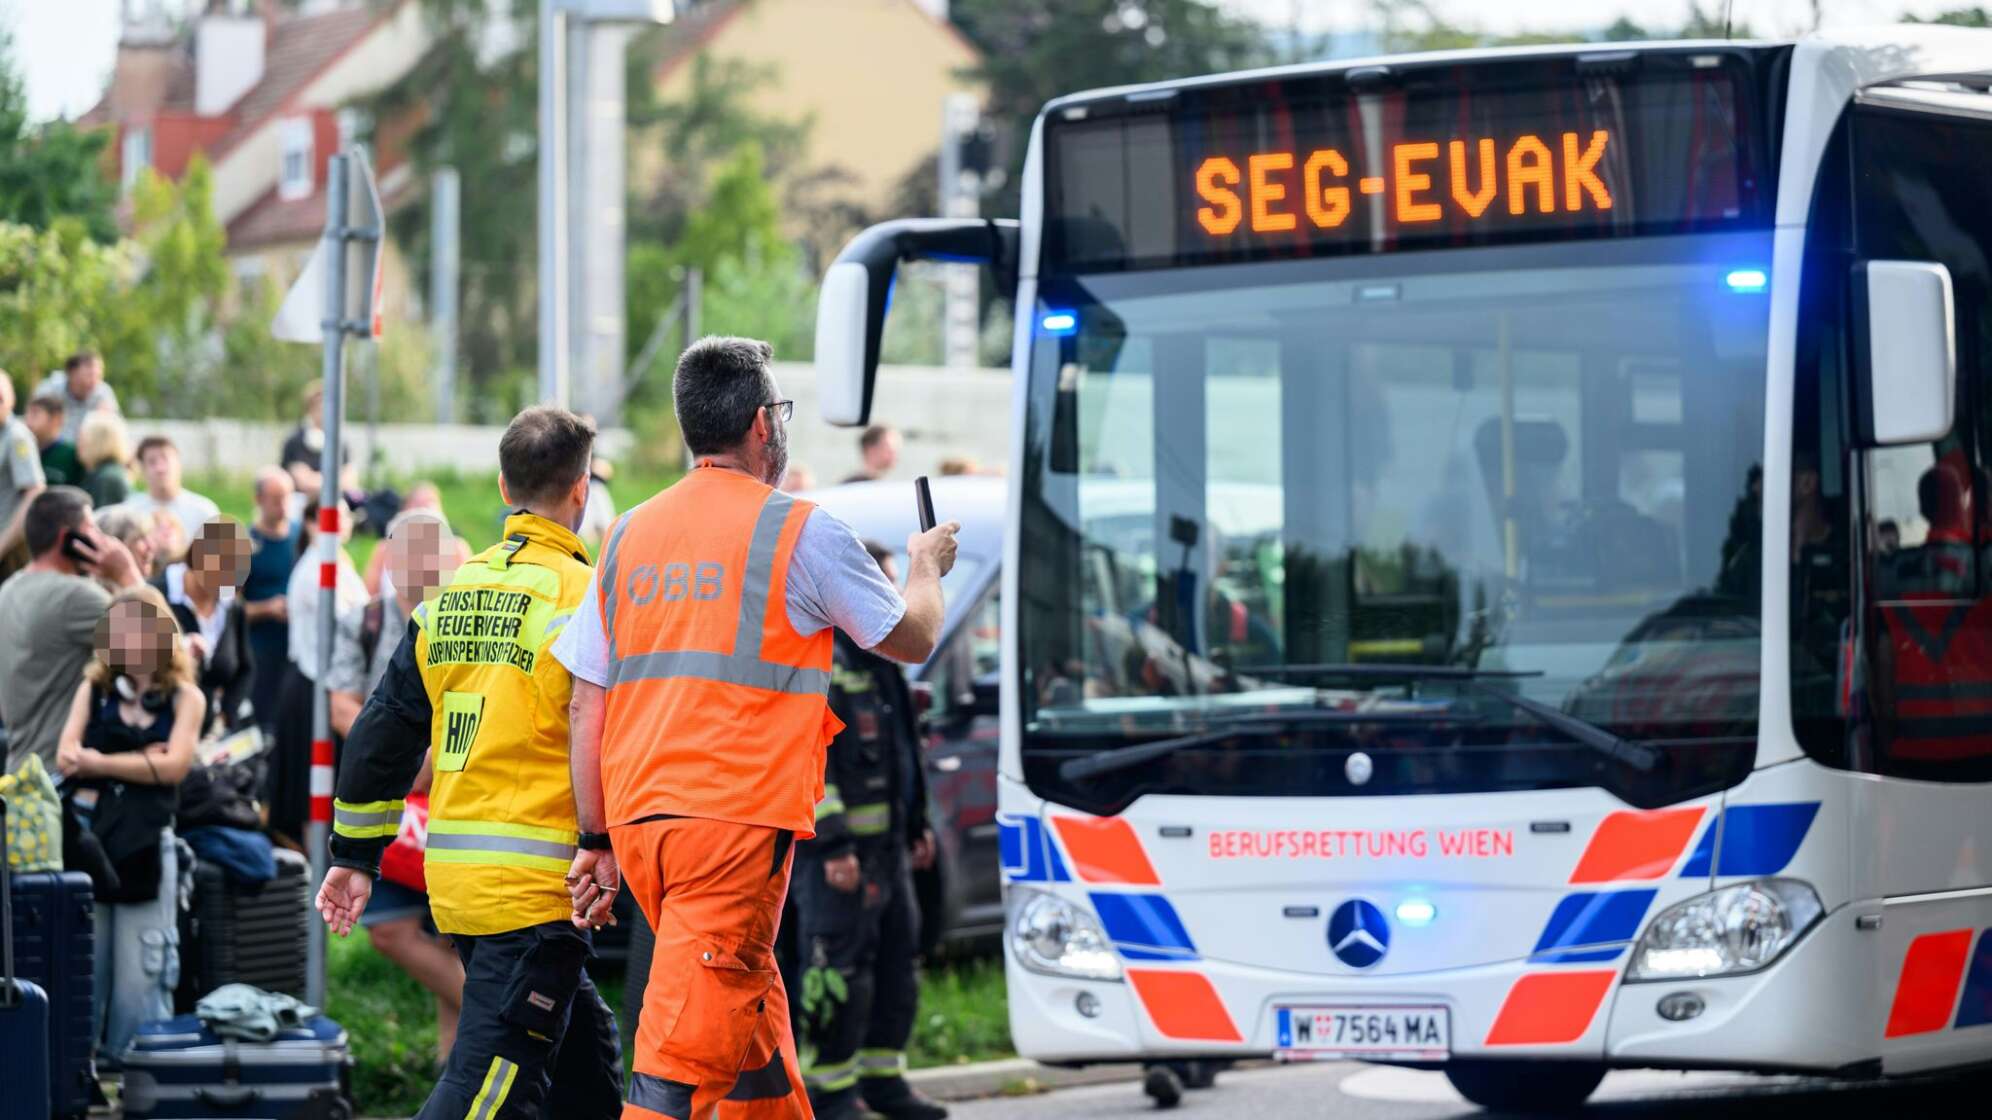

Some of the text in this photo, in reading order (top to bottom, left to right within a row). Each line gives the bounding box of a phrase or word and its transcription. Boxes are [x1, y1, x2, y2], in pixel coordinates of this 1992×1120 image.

[1195, 129, 1613, 235] SEG-EVAK
[1209, 829, 1514, 858] BERUFSRETTUNG WIEN
[1295, 1014, 1441, 1043] W 7564 MA
